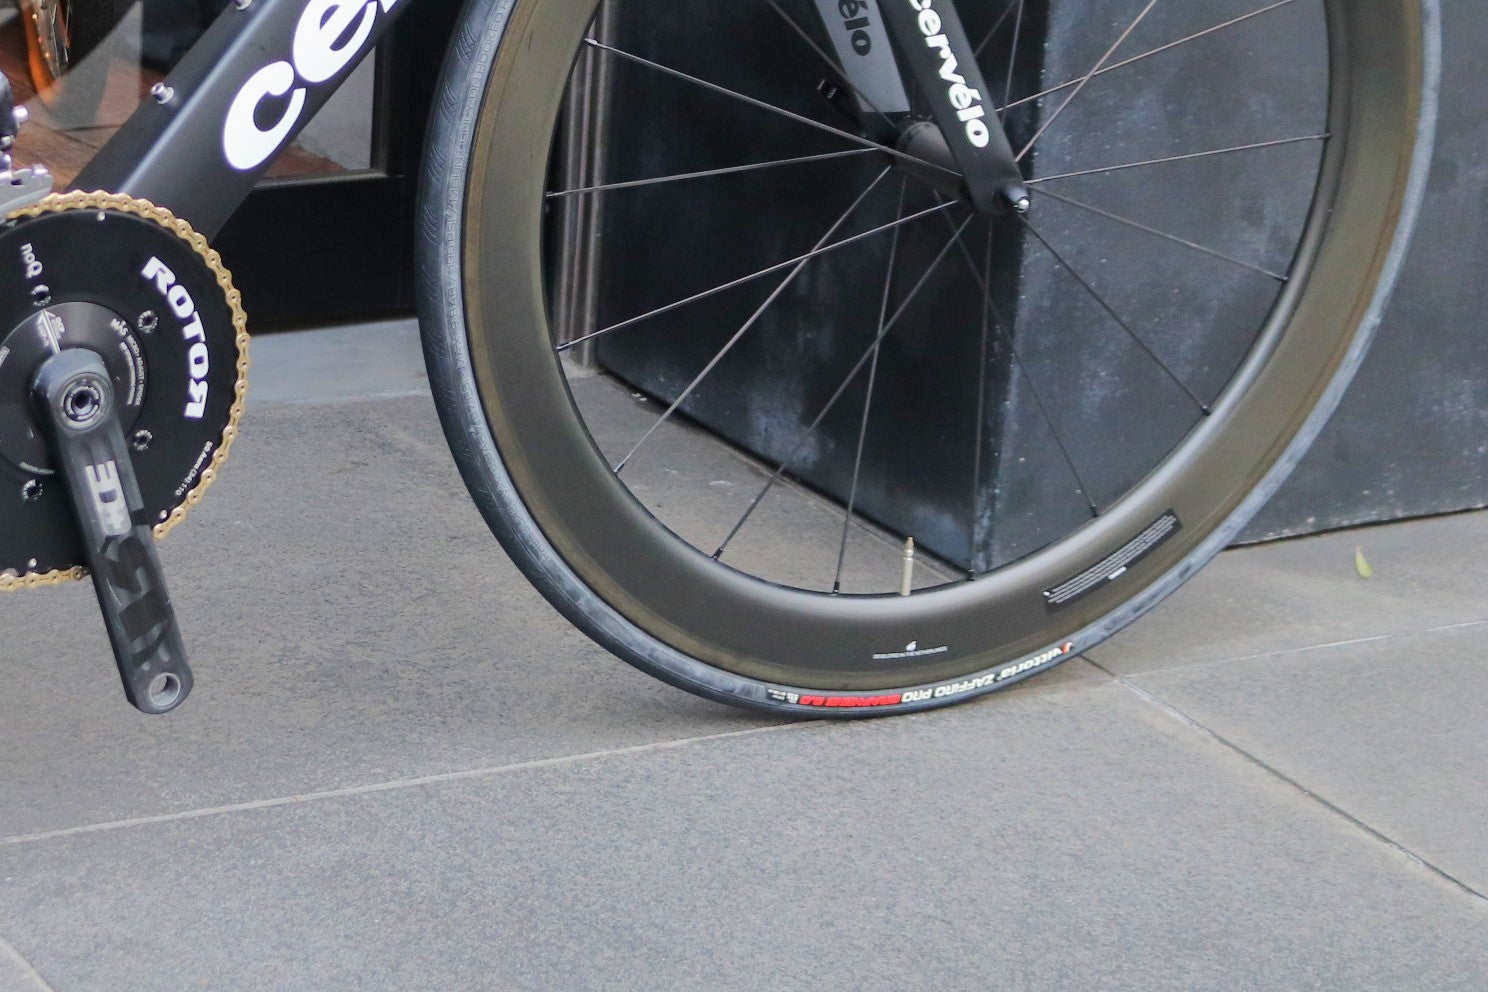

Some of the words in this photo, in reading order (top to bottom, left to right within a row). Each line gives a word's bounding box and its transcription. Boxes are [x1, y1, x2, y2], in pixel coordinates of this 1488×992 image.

[141, 256, 209, 418] ROTOR
[1001, 647, 1062, 678] vittoria
[901, 688, 934, 704] PRO
[935, 673, 995, 698] ZAFFIRO
